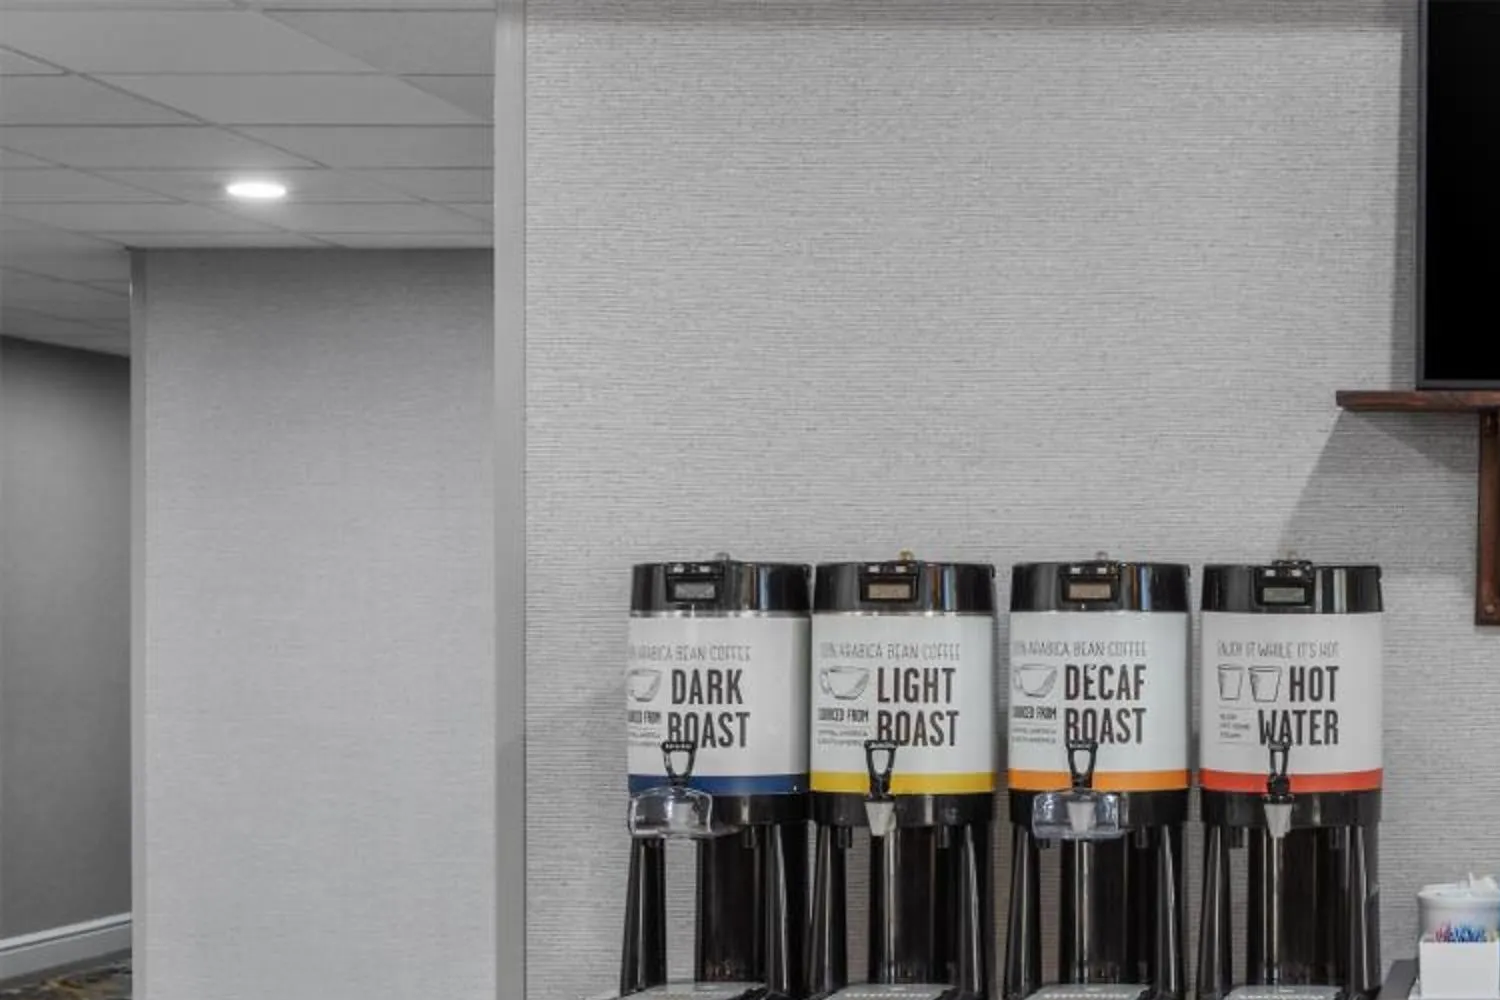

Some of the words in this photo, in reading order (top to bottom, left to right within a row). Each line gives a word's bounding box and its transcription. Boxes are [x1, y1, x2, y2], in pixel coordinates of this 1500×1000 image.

[671, 668, 743, 705] DARK
[877, 667, 956, 704] LIGHT
[1064, 664, 1147, 701] DECAF
[1289, 665, 1339, 703] HOT
[667, 711, 751, 749] ROAST
[877, 710, 960, 747] ROAST
[1064, 707, 1147, 744] ROAST
[1258, 709, 1339, 746] WATER
